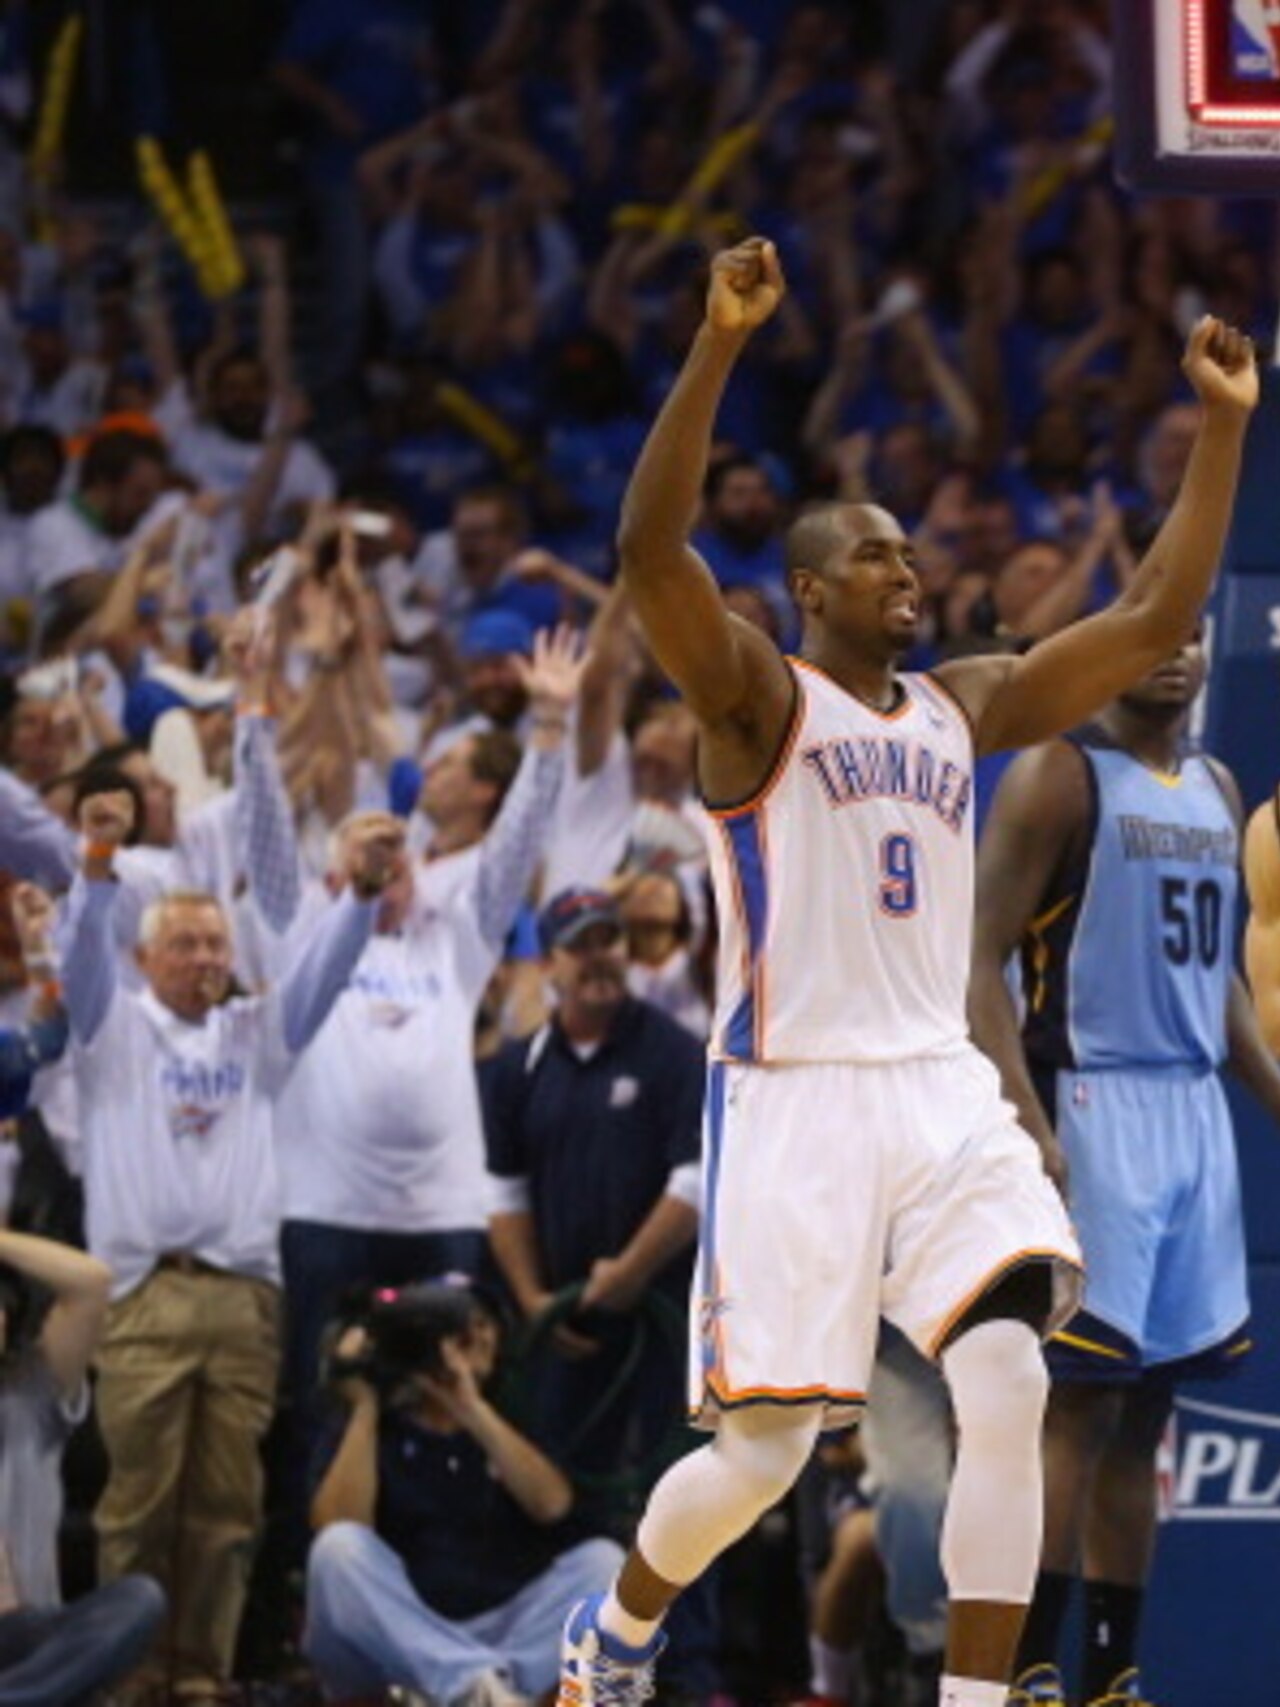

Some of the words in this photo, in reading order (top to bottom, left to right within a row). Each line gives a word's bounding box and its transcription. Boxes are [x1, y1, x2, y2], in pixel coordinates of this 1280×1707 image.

[802, 737, 970, 834] THUNDER
[879, 832, 917, 919] 9
[1161, 876, 1222, 971] 50
